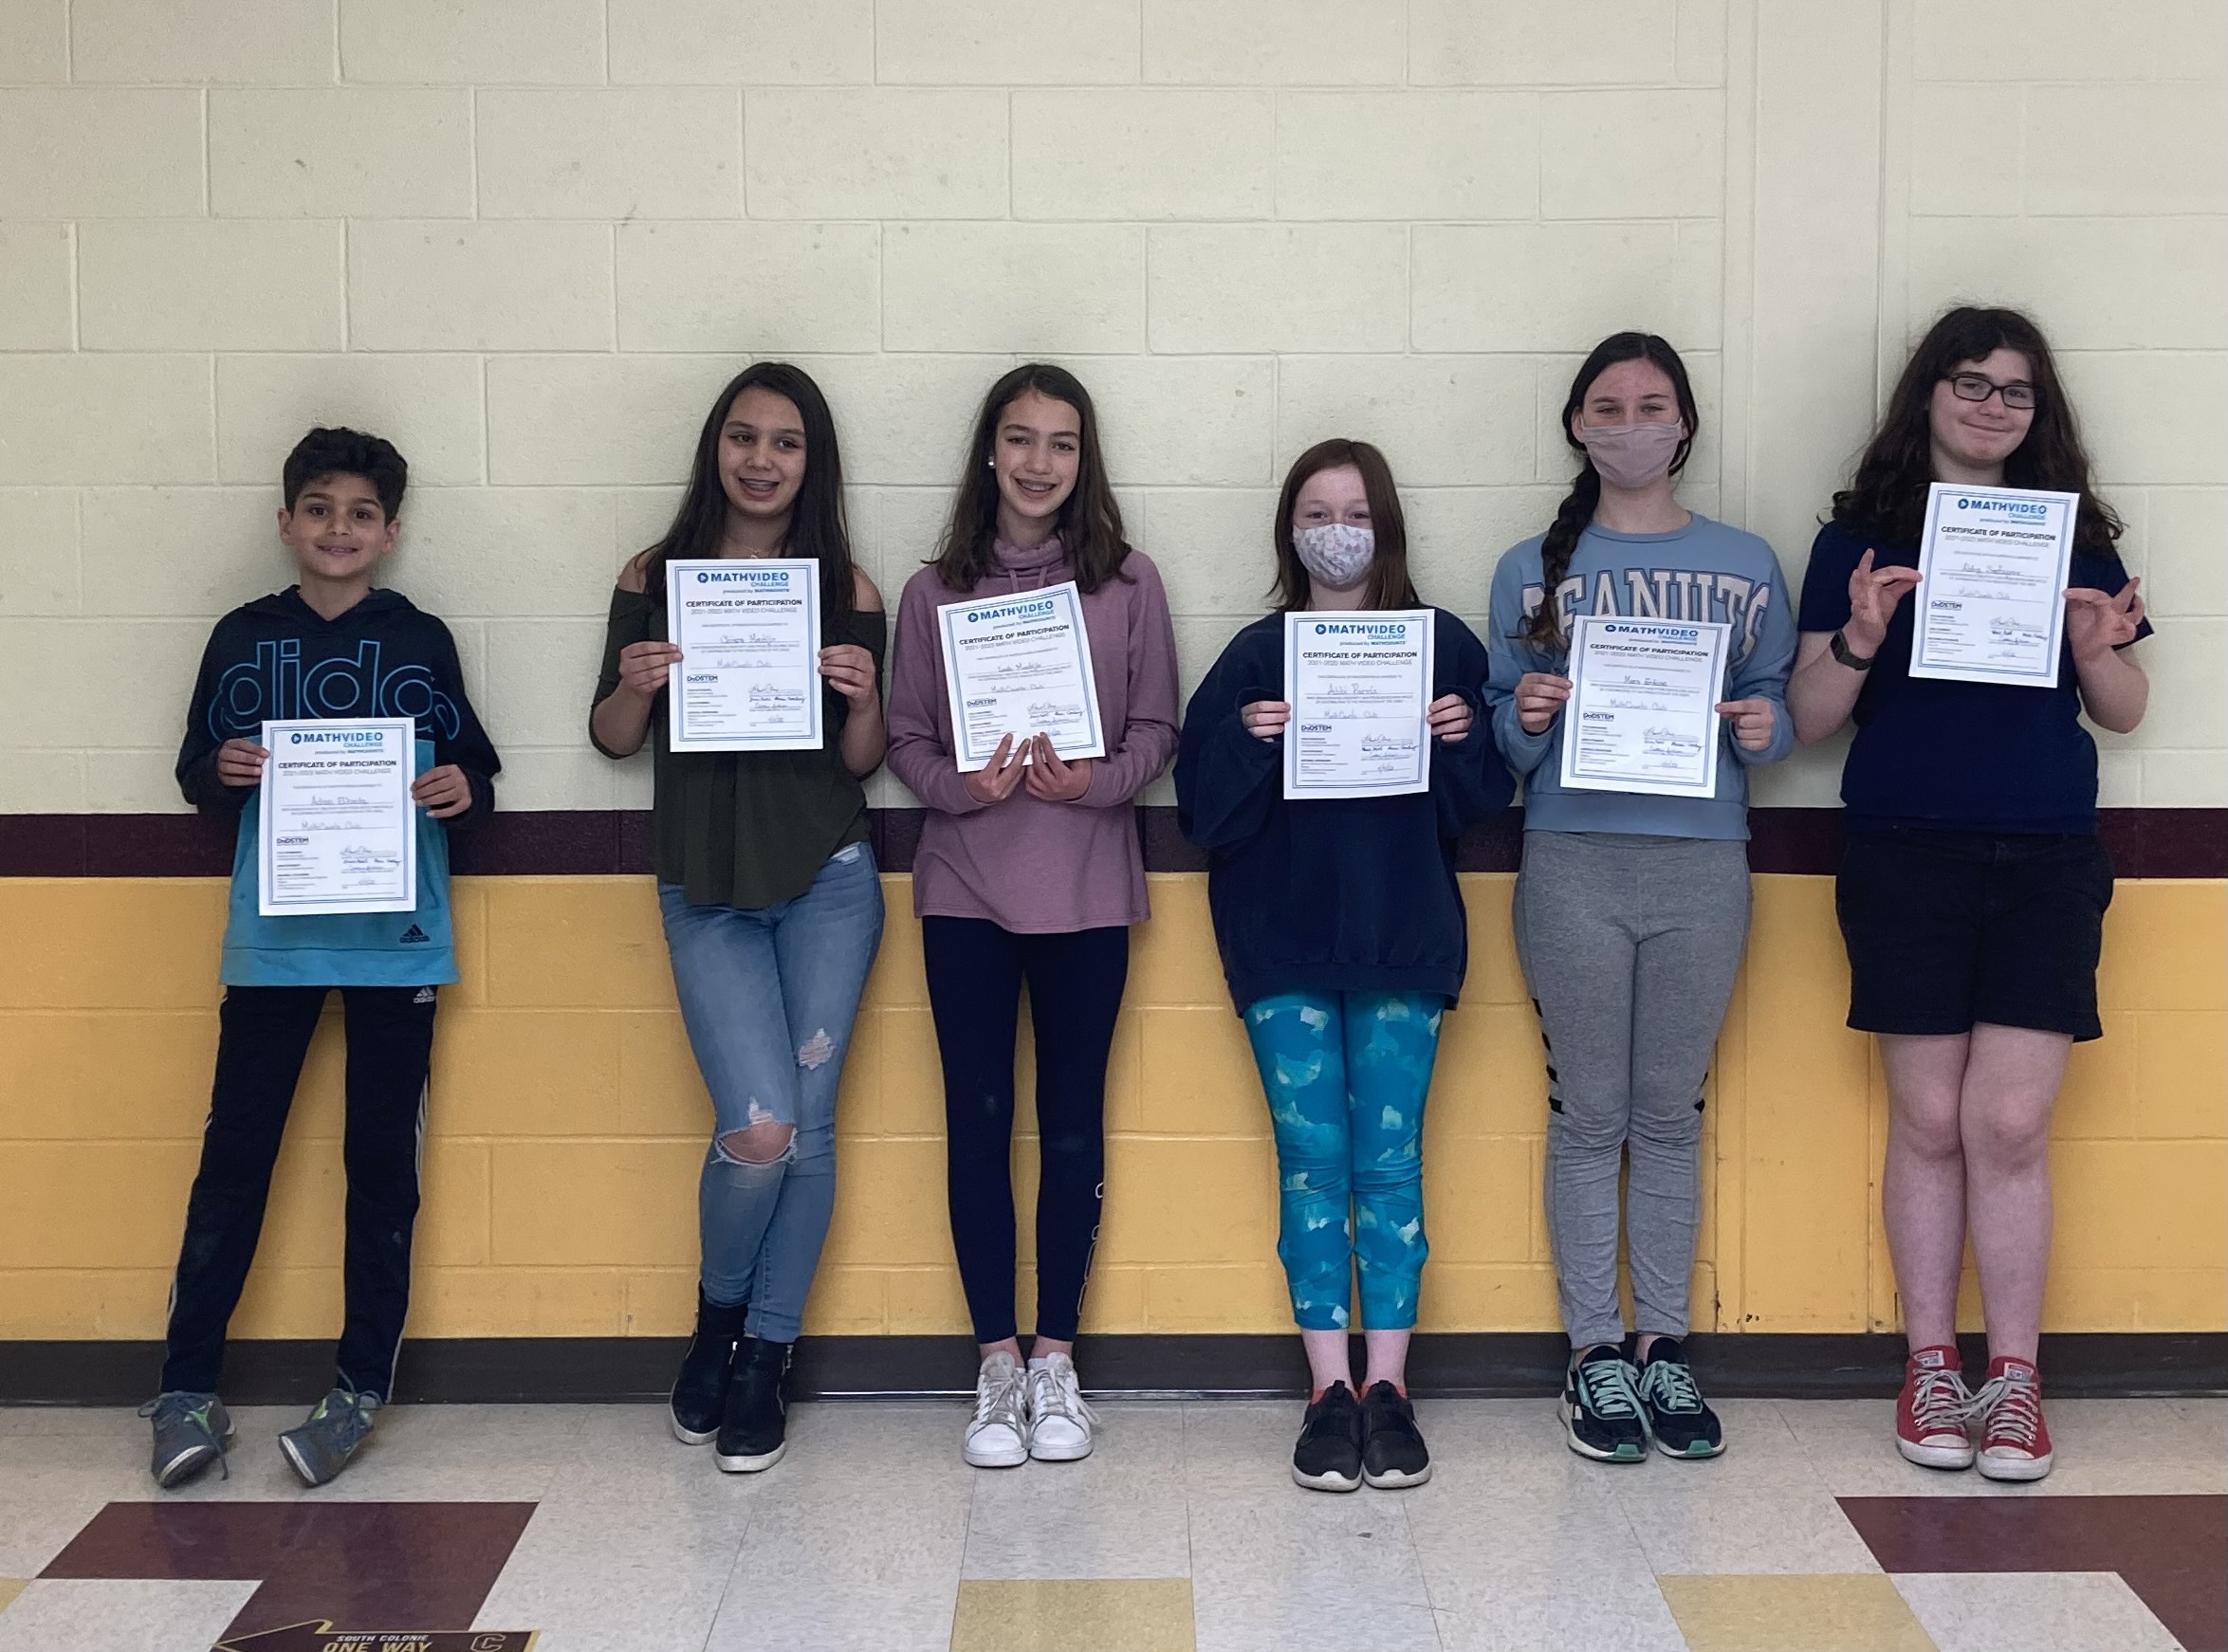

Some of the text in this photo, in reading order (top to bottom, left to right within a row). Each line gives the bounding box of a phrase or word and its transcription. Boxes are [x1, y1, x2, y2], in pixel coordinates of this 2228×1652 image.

[1971, 501, 2047, 514] MATHVIDEO
[1942, 526, 1987, 536] CERTIFICATE
[2001, 531, 2055, 541] PARTICIPATION
[2014, 540, 2049, 548] CHALLENGE
[711, 572, 789, 581] MATHVIDEO
[980, 601, 1054, 620] MATHVIDEO
[1019, 610, 1054, 619] CHALLENGE
[1329, 625, 1406, 633] MATHVIDEO
[1618, 626, 1699, 636] MATHVIDEO
[959, 633, 1004, 645] CERTIFICATE
[1017, 624, 1069, 637] PARTICIPATION
[1031, 633, 1065, 642] CHALLENGE
[304, 732, 382, 743] MATHVIDEO
[323, 1642, 433, 1652] ONE WAY
